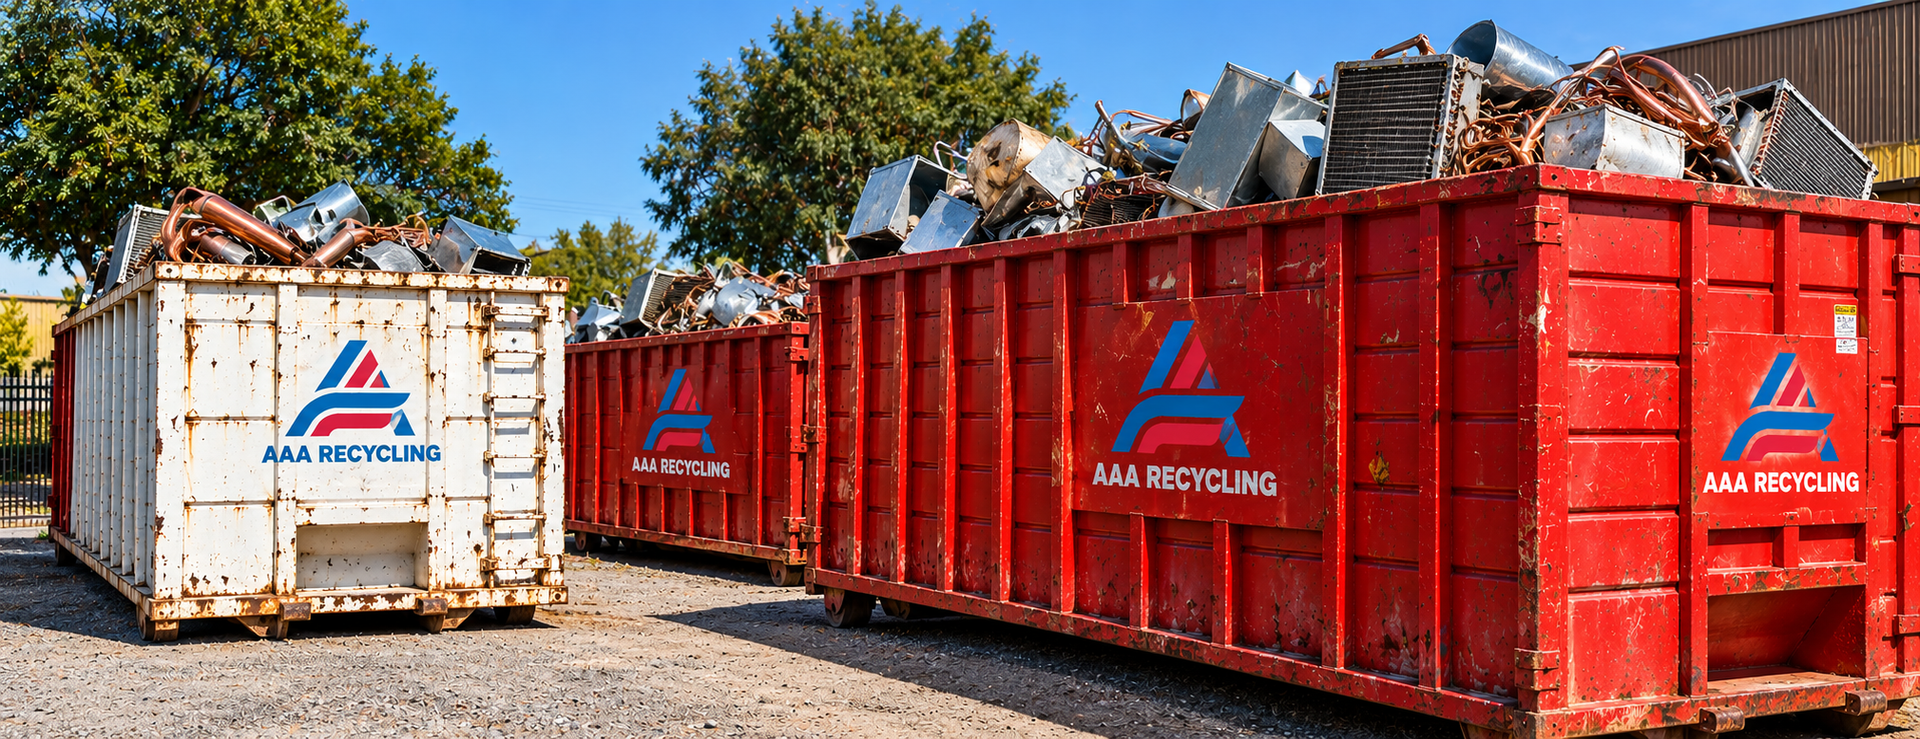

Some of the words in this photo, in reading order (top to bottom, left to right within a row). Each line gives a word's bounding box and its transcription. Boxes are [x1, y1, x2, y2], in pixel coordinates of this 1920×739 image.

[262, 444, 312, 464] AAA
[319, 444, 442, 464] RECYCLING
[631, 456, 658, 473] AAA
[660, 458, 730, 479] RECYCLING
[1092, 462, 1141, 489] AAA
[1146, 464, 1277, 497] RECYCLING
[1702, 471, 1749, 494] AAA
[1754, 471, 1860, 493] RECYCLING
